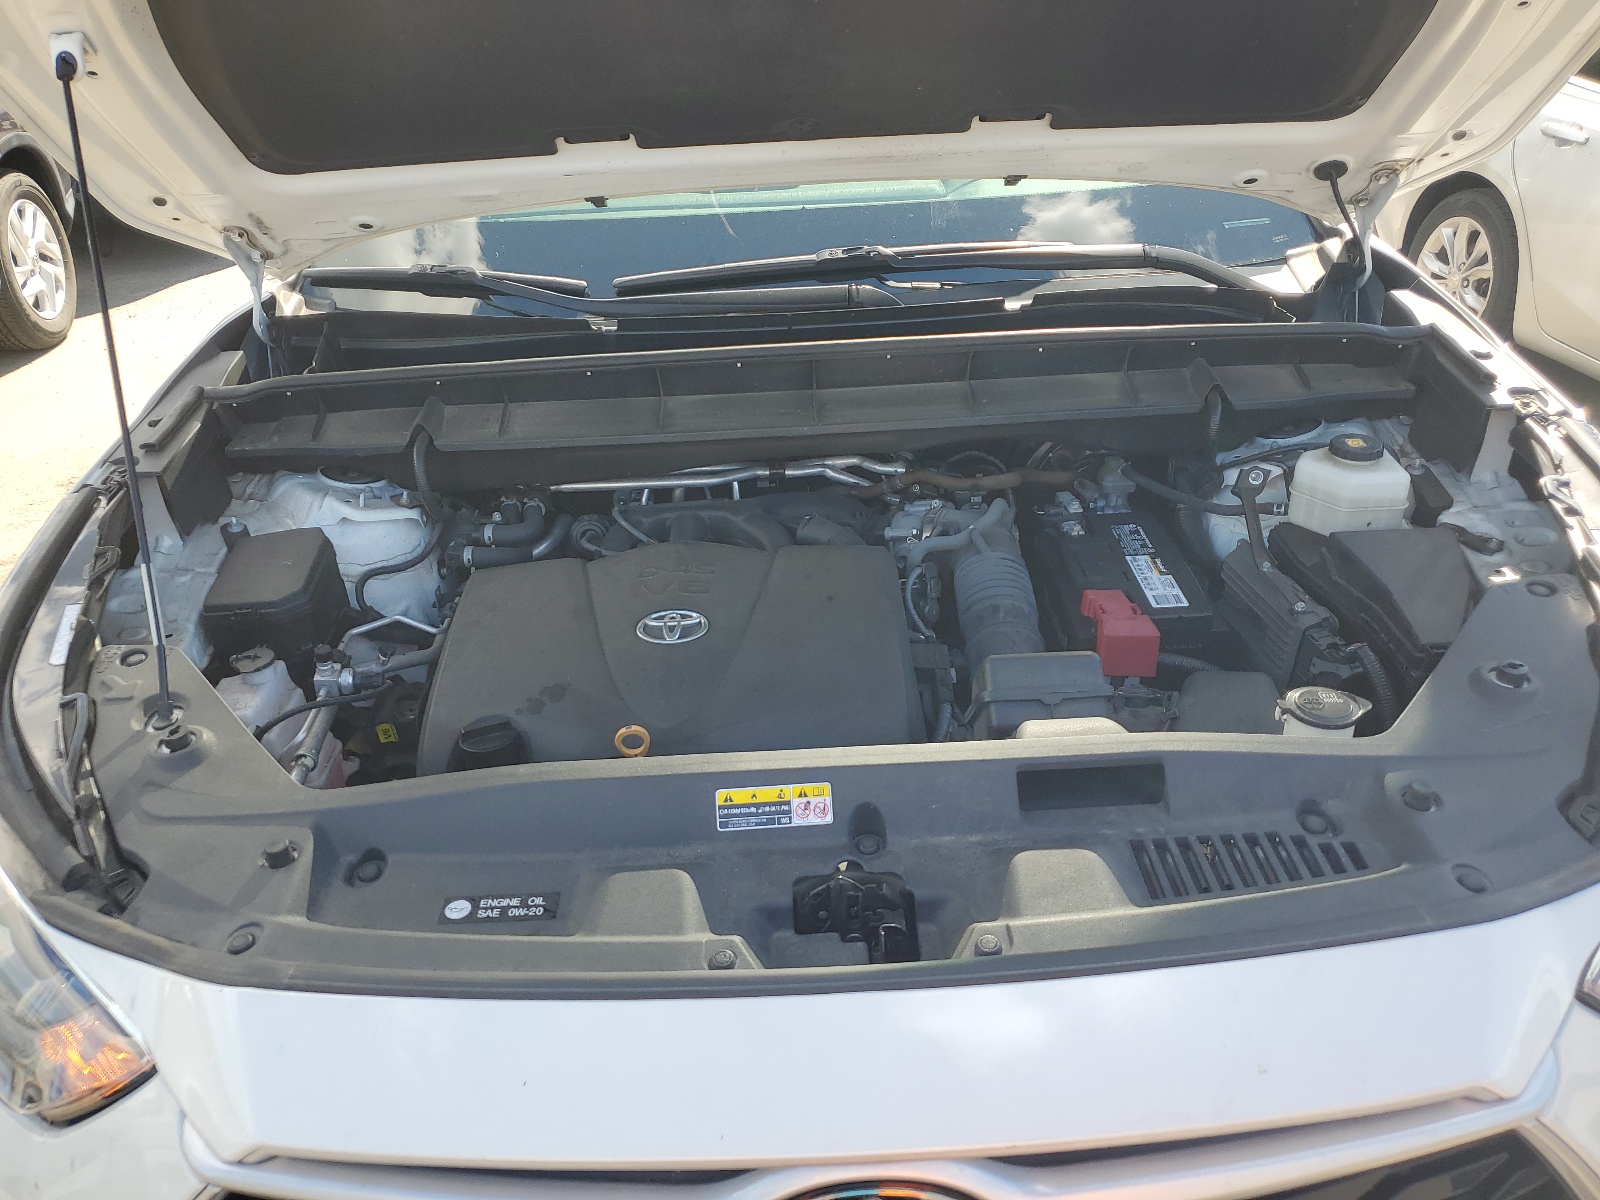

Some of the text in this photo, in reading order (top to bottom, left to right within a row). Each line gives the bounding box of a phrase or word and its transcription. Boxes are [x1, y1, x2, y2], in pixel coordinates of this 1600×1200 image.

[640, 580, 710, 596] V6
[479, 896, 546, 908] ENGINE OIL
[477, 907, 545, 918] SAE 0W-20
